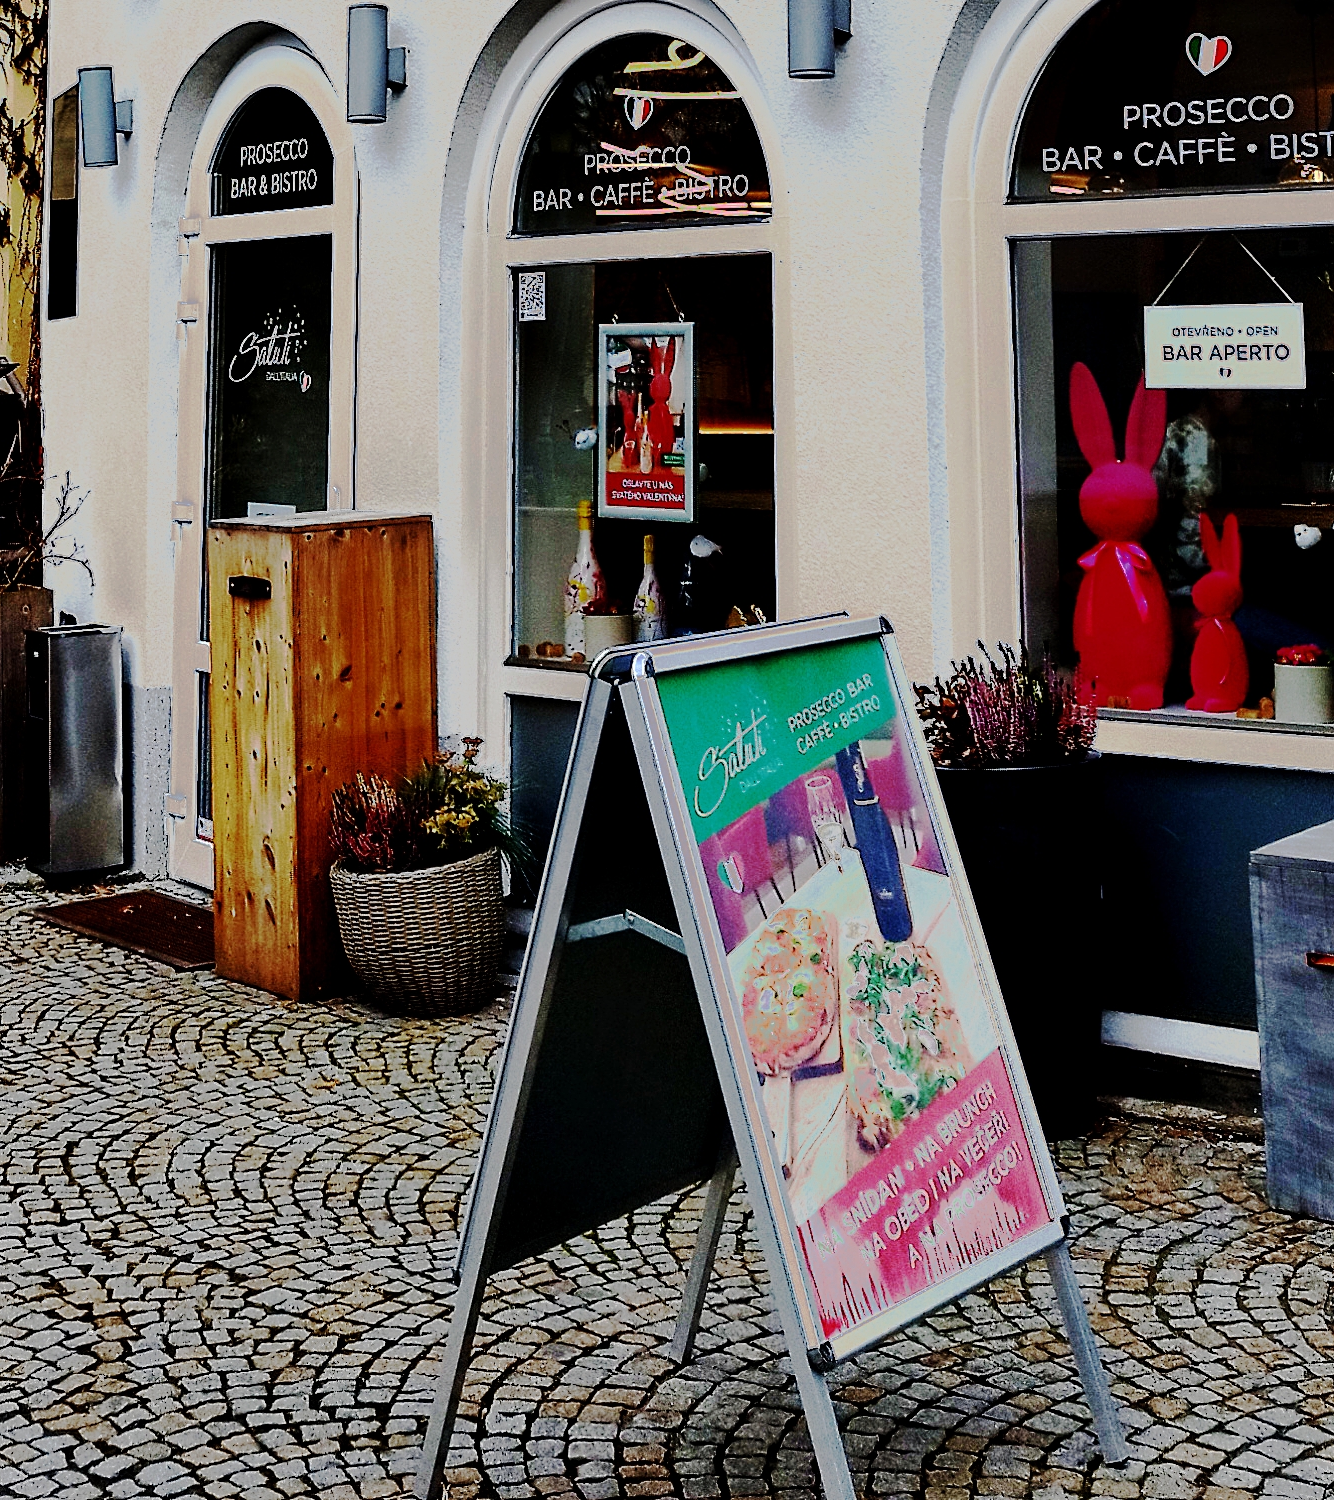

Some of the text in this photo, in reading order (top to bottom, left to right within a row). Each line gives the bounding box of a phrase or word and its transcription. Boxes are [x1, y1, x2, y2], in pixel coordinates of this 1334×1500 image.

[1123, 93, 1294, 130] PROSECCO
[240, 138, 308, 167] PROSECCO
[584, 145, 691, 175] PROSECCO
[1042, 145, 1103, 172] BAR
[1133, 132, 1236, 168] CAFFÈ
[230, 168, 318, 198] BAR & BISTRO
[533, 174, 749, 212] BAR CAFFÈ BISTRO
[1172, 324, 1279, 337] OTEVŘENO OPEN
[1162, 344, 1290, 361] BAR APERTO
[787, 673, 874, 733] PROSECCO BAR
[796, 694, 881, 755] CAFFÈ BISTRO
[817, 1226, 845, 1262] NA
[913, 1135, 944, 1168] NA
[936, 1081, 998, 1146] BRUNCH
[861, 1231, 888, 1261] NA
[937, 1159, 964, 1192] NA
[908, 1243, 923, 1269] A
[918, 1217, 945, 1246] NA
